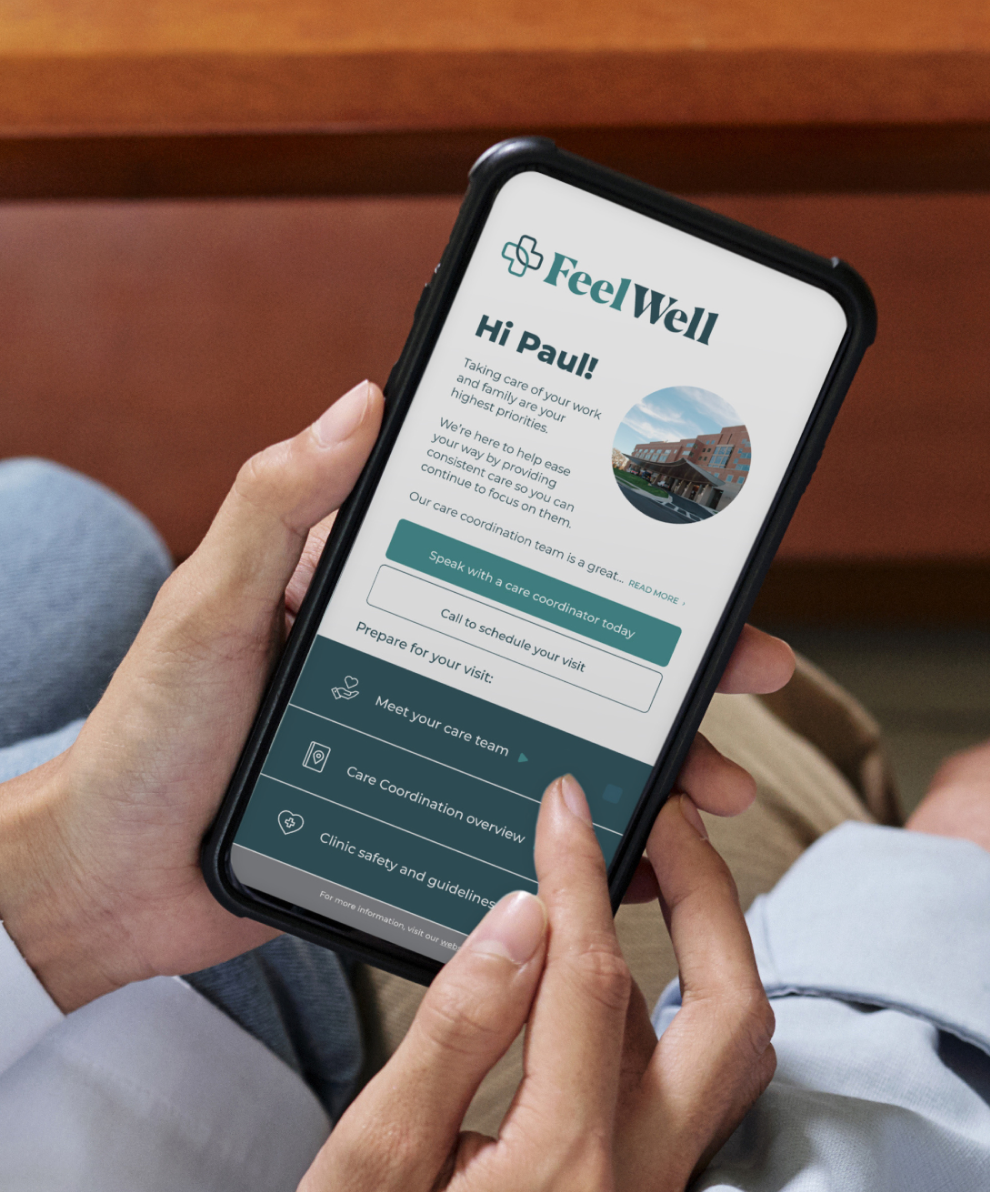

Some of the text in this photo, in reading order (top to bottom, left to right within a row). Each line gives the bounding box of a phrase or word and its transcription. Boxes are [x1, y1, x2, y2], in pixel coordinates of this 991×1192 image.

[543, 251, 719, 346] FeelWell
[474, 314, 599, 380] Hi Paul!
[450, 386, 548, 434] highest priorities.
[456, 374, 566, 423] and family are your
[464, 357, 602, 420] Taking care of your work
[430, 433, 558, 490] your way by providing
[440, 416, 571, 477] We're here to help ease
[420, 463, 572, 529] continue to focus on them.
[426, 448, 575, 513] consistent care so you can
[409, 491, 624, 584] Our care coordination team is a great...
[428, 550, 636, 640] Speak with a care coordinator today
[628, 579, 680, 605] READ MORE
[355, 621, 494, 684] Prepare for your visit:
[440, 608, 586, 673] Call to schedule your visit
[375, 695, 509, 757] Meet your care team
[346, 766, 526, 844] Care Coordination overview
[319, 832, 497, 910] Clinic safety and guidelines
[319, 890, 334, 901] For
[334, 897, 357, 911] more
[357, 905, 406, 931] information,
[407, 926, 425, 938] visit
[424, 933, 440, 943] our
